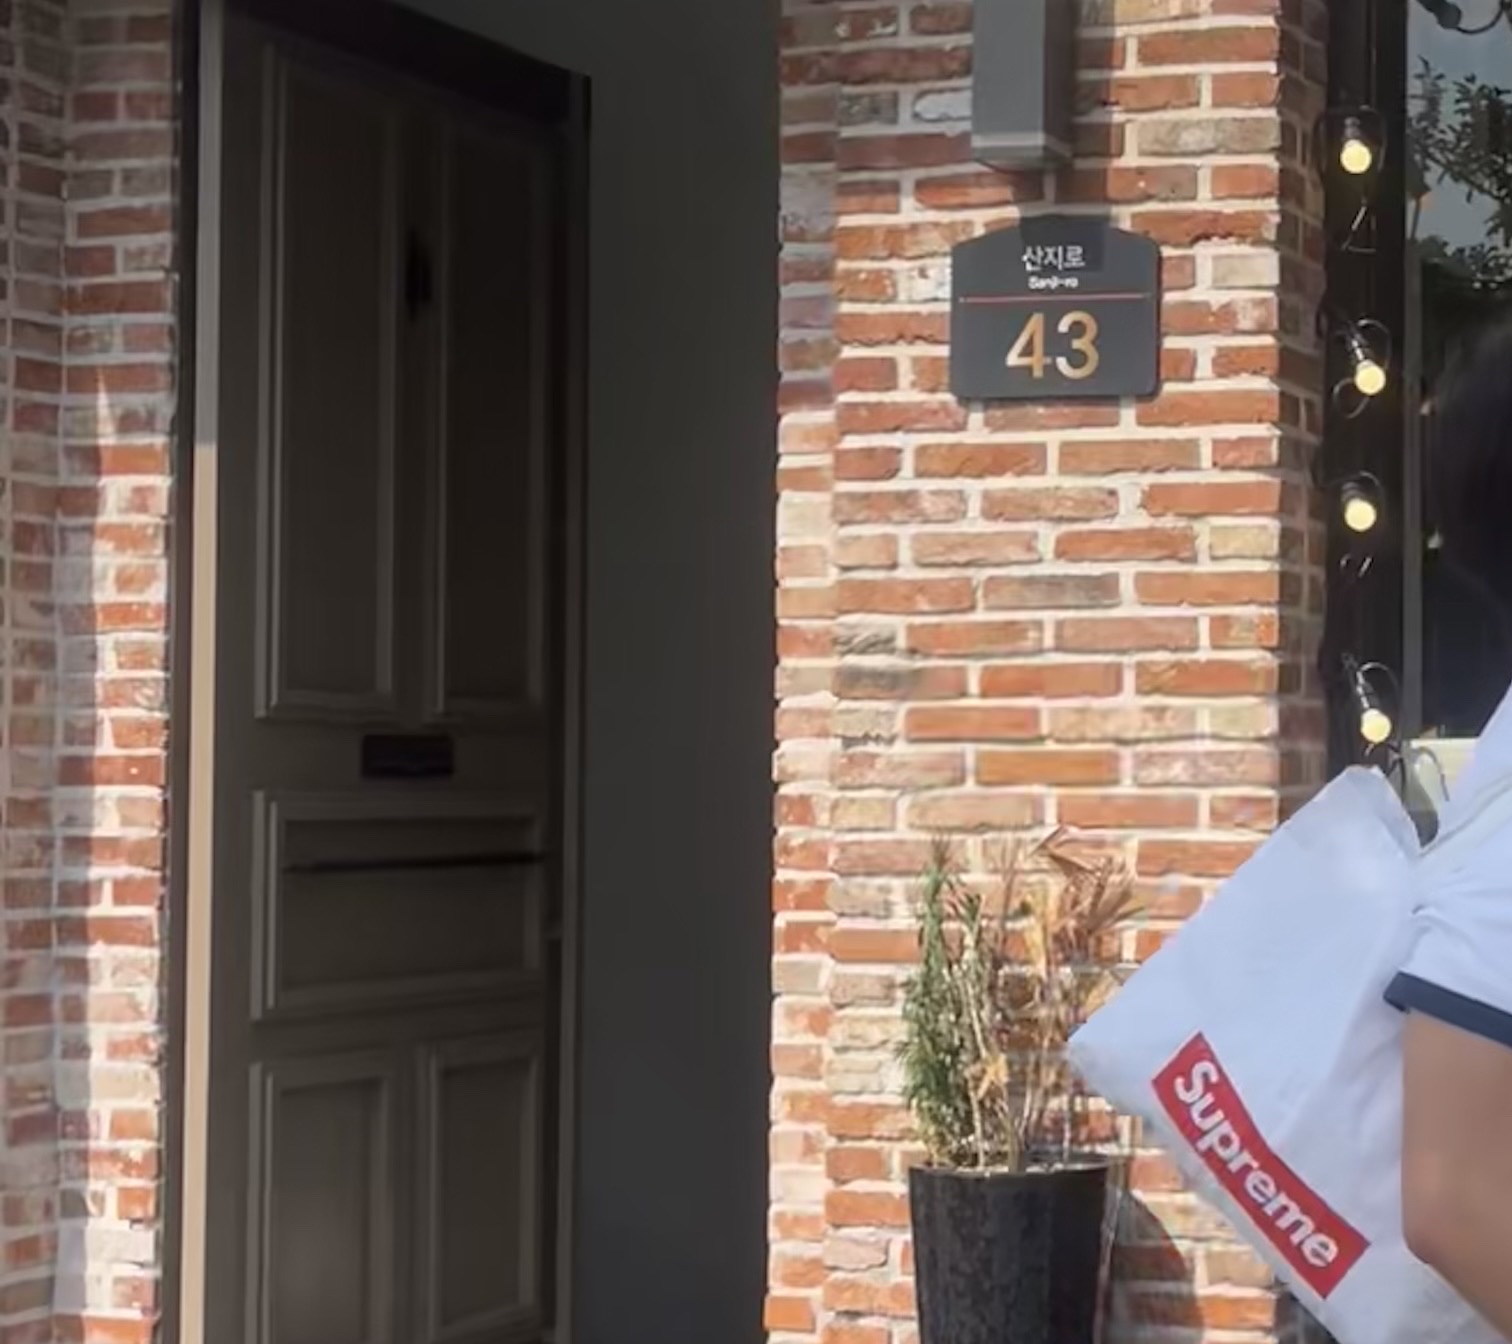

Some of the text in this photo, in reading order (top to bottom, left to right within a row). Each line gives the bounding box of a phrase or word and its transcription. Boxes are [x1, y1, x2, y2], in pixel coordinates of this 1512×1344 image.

[1021, 244, 1086, 271] 산지로
[1005, 310, 1099, 379] 43
[1174, 1059, 1338, 1267] Supreme
